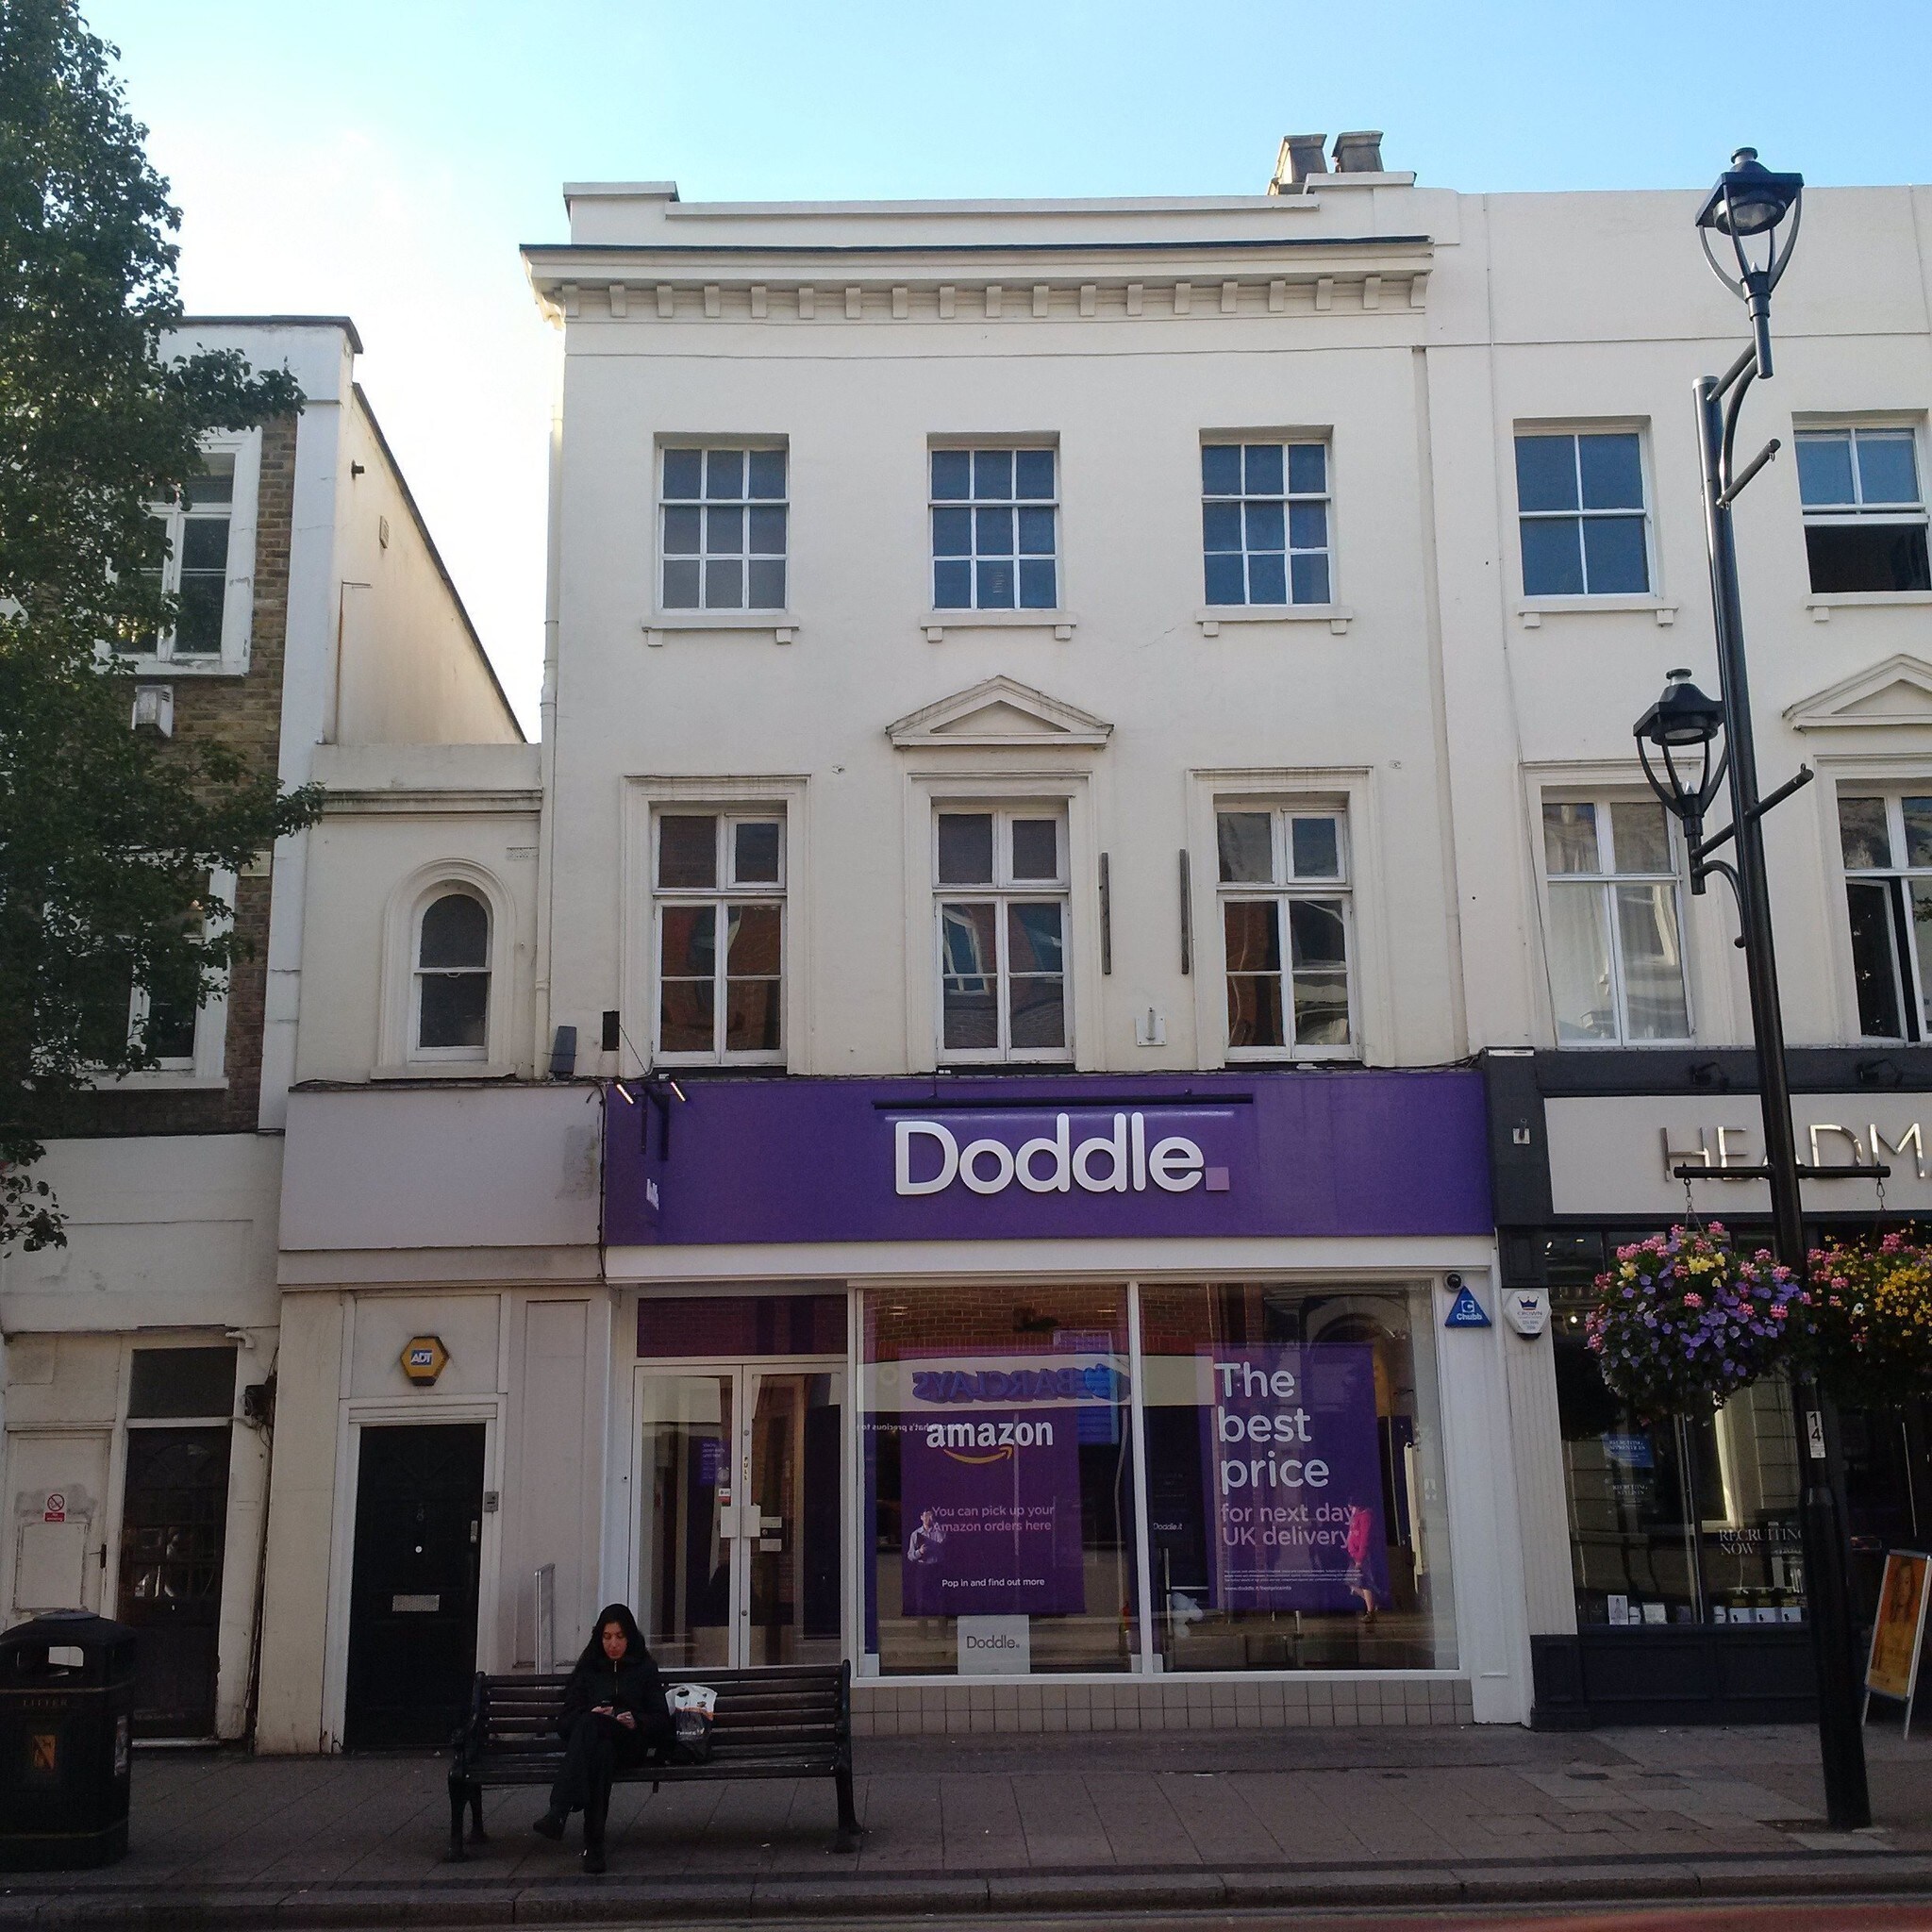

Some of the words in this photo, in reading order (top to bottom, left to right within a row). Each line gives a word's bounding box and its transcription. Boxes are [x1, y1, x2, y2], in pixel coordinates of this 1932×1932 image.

[1660, 1123, 1925, 1181] HEDM
[1456, 1312, 1483, 1321] Chubb
[410, 1352, 433, 1363] ADT
[1213, 1361, 1295, 1398] The
[1218, 1406, 1312, 1442] best
[926, 1421, 1054, 1448] amazon
[1221, 1450, 1330, 1495] price
[932, 1507, 955, 1517] You
[958, 1507, 978, 1517] can
[981, 1505, 1007, 1518] pick
[1009, 1507, 1024, 1519] up
[1028, 1506, 1055, 1518] your
[1221, 1503, 1253, 1523] for
[1259, 1504, 1309, 1523] next
[1315, 1502, 1357, 1525] day
[932, 1522, 981, 1532] Amazon
[985, 1520, 1023, 1532] orders
[1025, 1520, 1052, 1531] here
[1223, 1526, 1256, 1546] UK
[1721, 1541, 1755, 1555] NOW
[941, 1578, 958, 1589] Pop
[960, 1578, 969, 1587] in
[970, 1578, 987, 1587] and
[988, 1577, 1005, 1587] find
[1007, 1578, 1021, 1587] out
[1023, 1578, 1045, 1587] more
